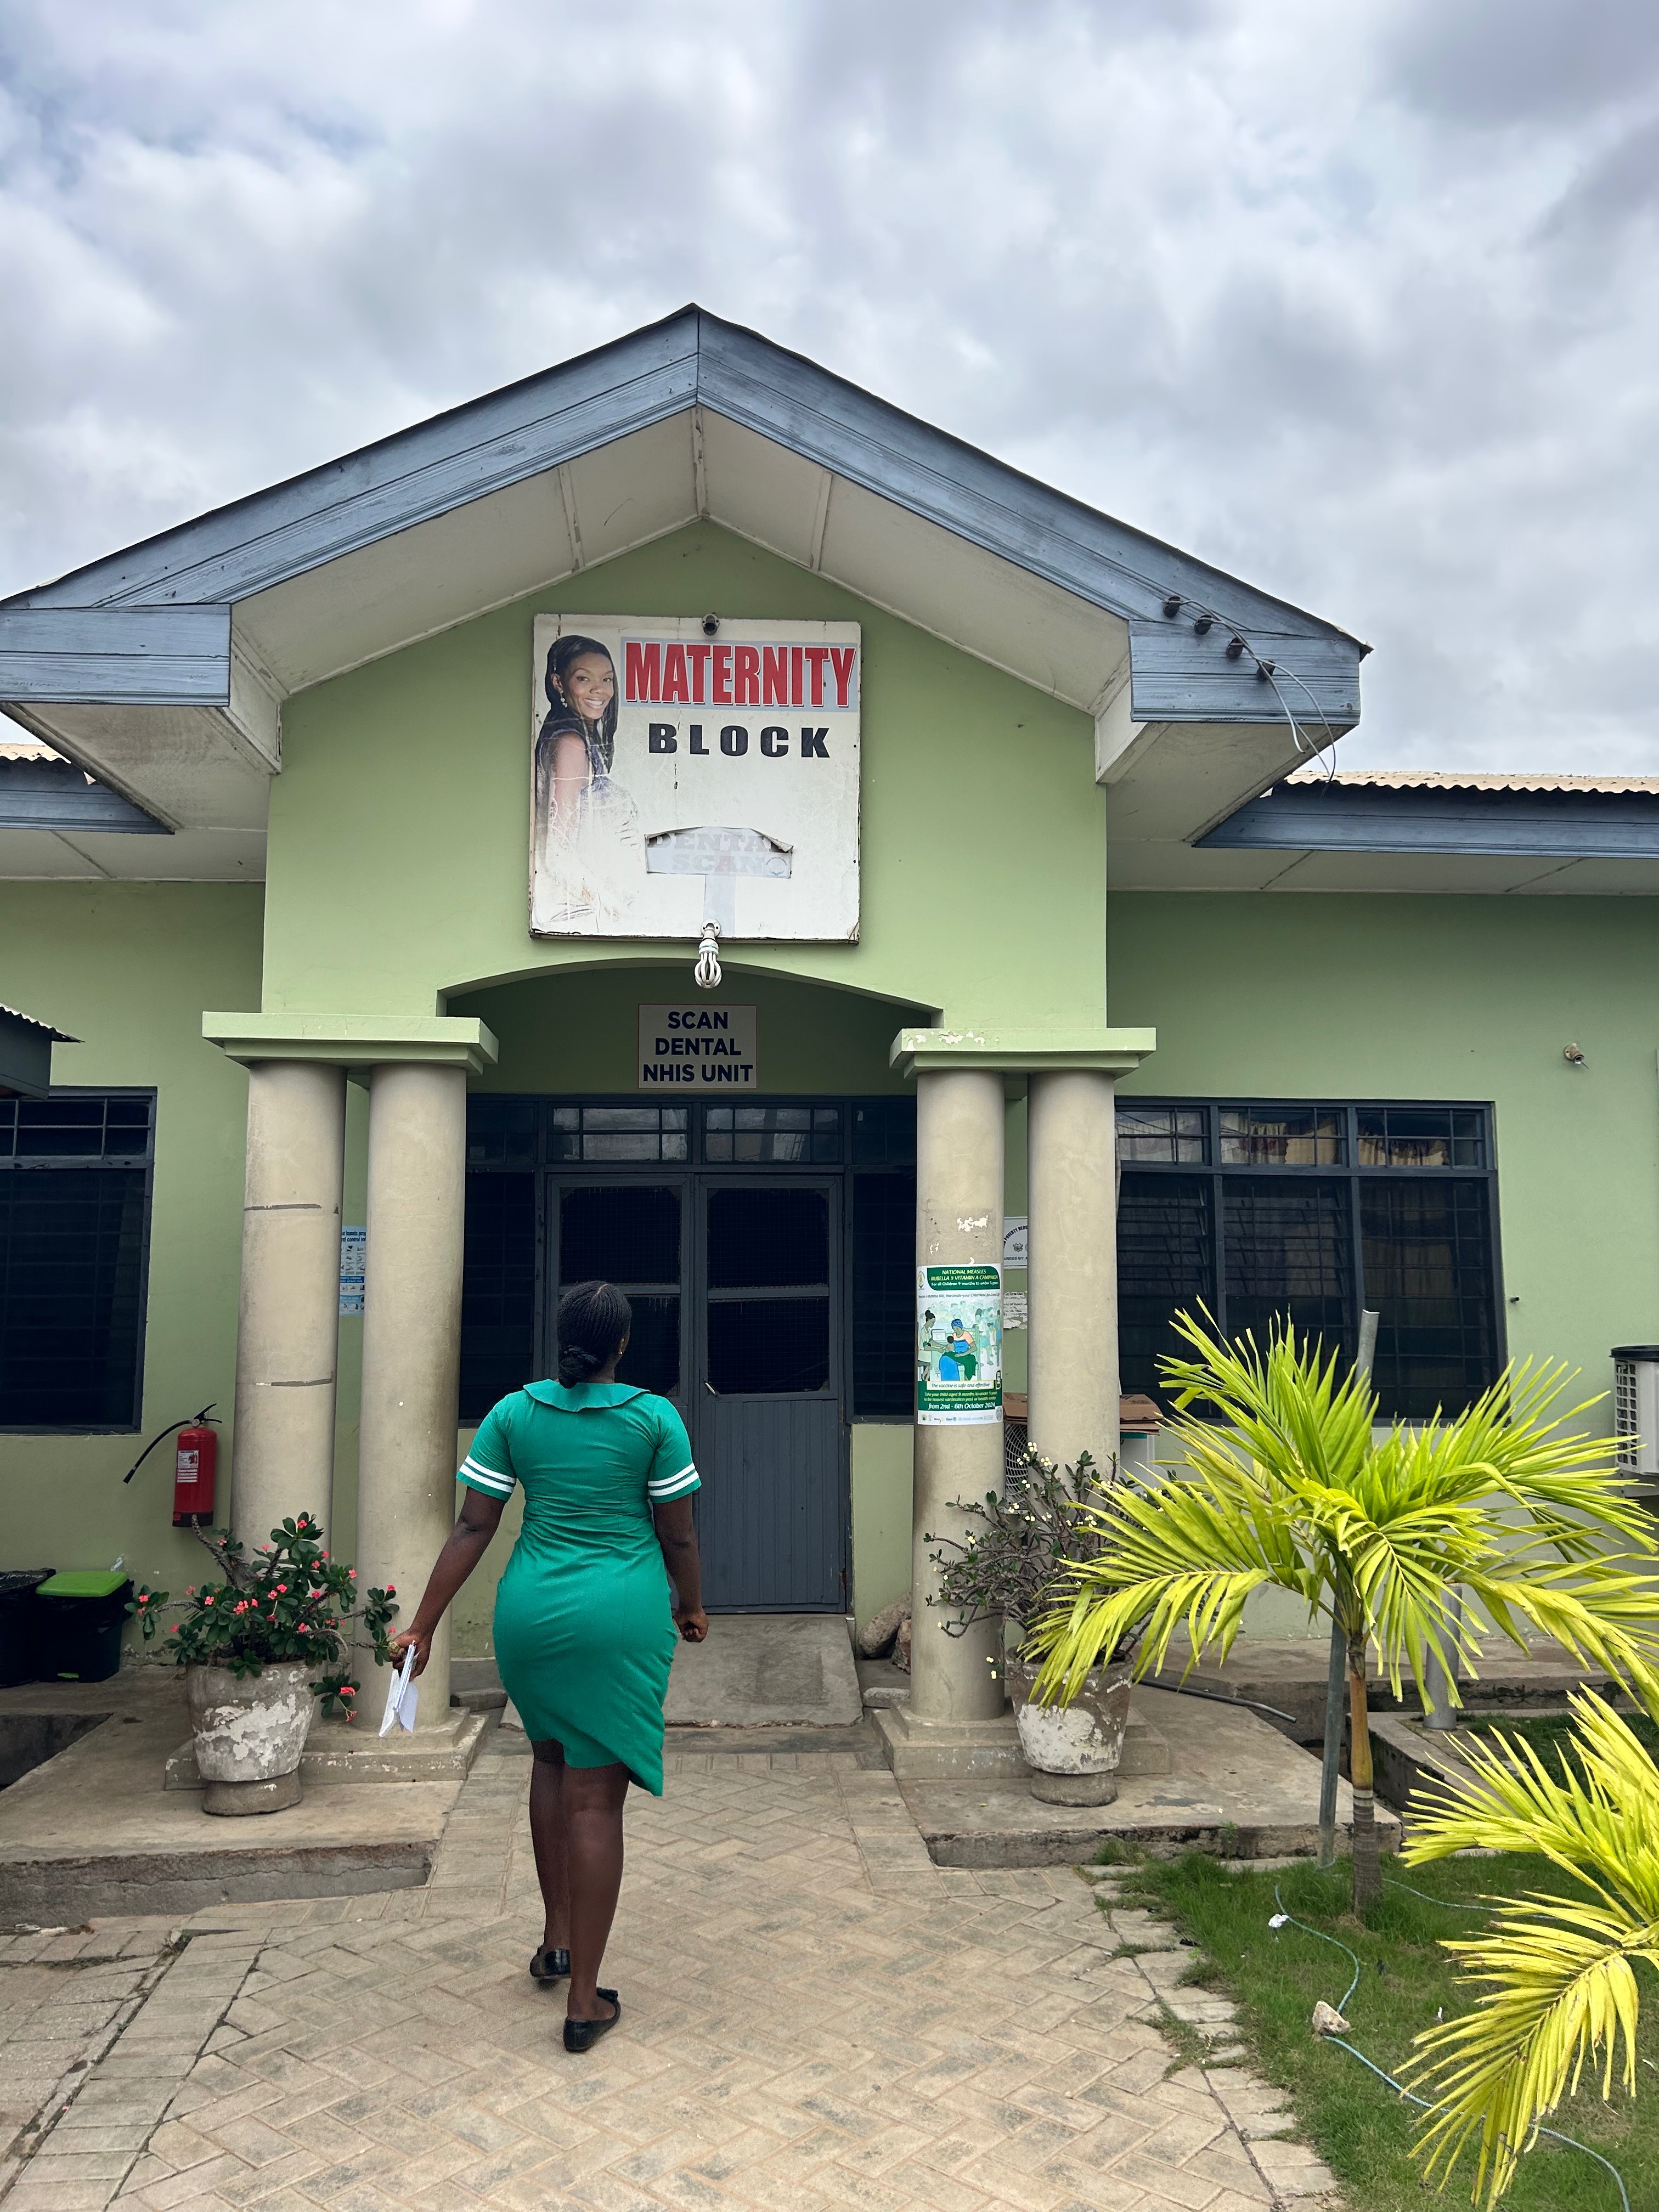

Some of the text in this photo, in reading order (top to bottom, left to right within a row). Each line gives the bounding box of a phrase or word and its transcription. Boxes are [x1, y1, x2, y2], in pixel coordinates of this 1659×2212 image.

[625, 642, 856, 708] MATERNITY
[648, 723, 831, 758] BLOCK
[672, 854, 764, 872] SCAN
[667, 1011, 728, 1029] SCAN
[655, 1037, 742, 1056] DENTAL
[643, 1064, 753, 1082] NHIS UNIT
[1004, 1228, 1018, 1241] POVERTY
